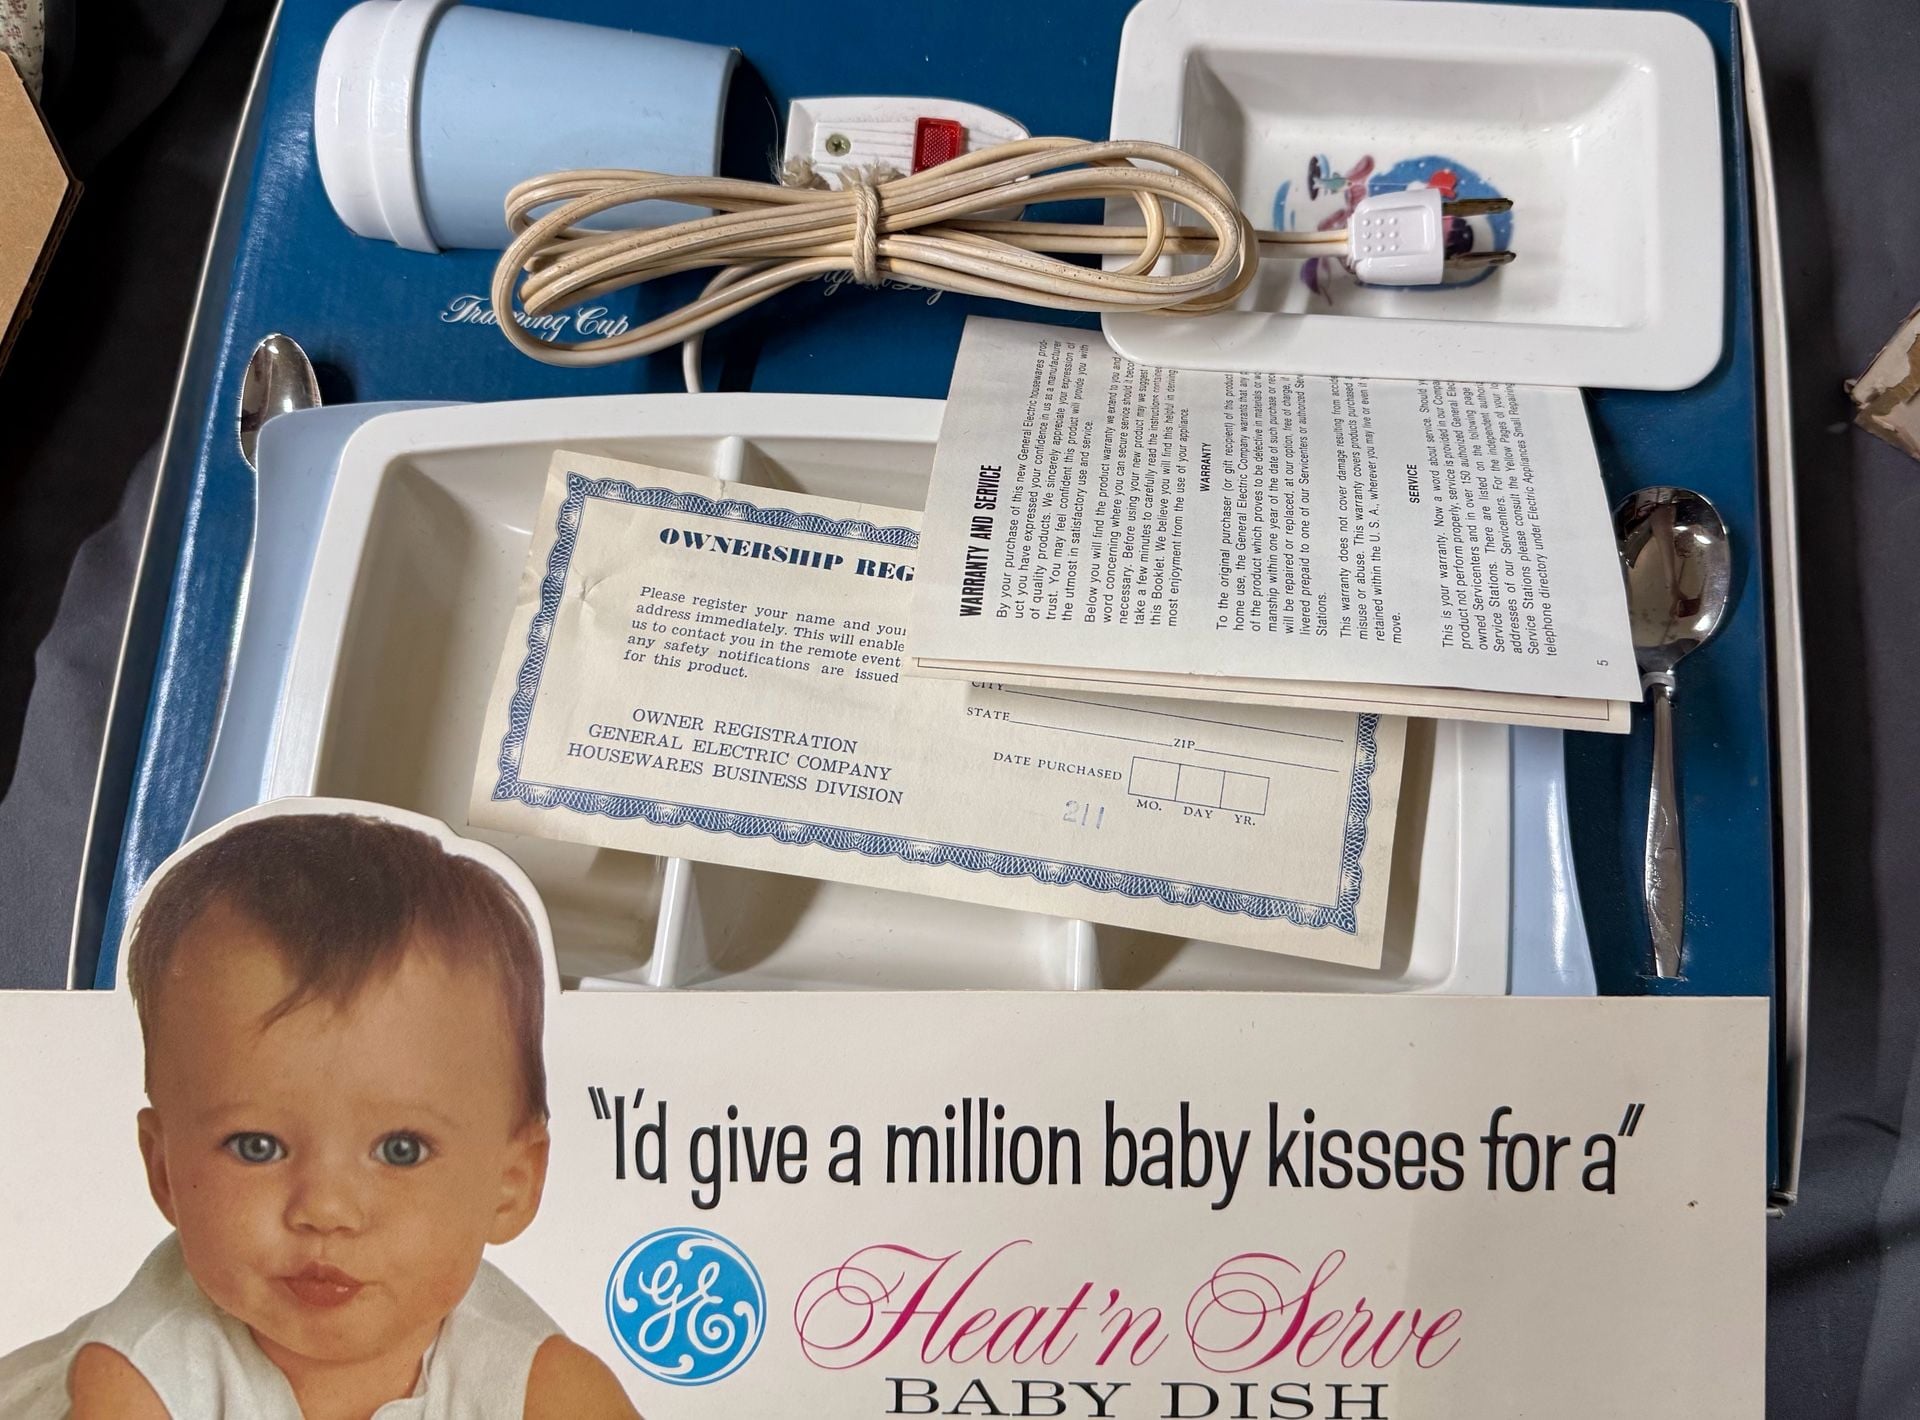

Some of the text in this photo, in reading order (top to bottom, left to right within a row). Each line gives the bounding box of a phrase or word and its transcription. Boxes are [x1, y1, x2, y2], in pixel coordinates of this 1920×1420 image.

[440, 294, 629, 342] Traning Cup
[1046, 340, 1061, 385] manufacturer
[1079, 345, 1088, 359] with
[1061, 353, 1074, 389] expression
[1074, 378, 1085, 399] provide
[1058, 391, 1068, 404] your
[1072, 403, 1081, 414] will
[1417, 388, 1430, 413] Should
[1034, 423, 1048, 464] confidence
[1052, 408, 1065, 445] appreciate
[1067, 417, 1078, 444] product
[1422, 417, 1435, 443] service.
[1045, 449, 1060, 488] sincerely
[1064, 449, 1075, 463] this
[1199, 442, 1212, 492] WARRANTY
[1426, 446, 1439, 466] about
[997, 340, 1048, 618] By your purchase of this new General Electric housewares prod-
[1032, 468, 1041, 488] your
[1058, 467, 1072, 509] confident
[1406, 464, 1420, 504] SERVICE
[1429, 470, 1441, 491] word
[1023, 492, 1038, 541] expressed
[1042, 493, 1053, 508] We
[1167, 408, 1189, 626] most enjoyment from the use of your appliance.
[1344, 383, 1368, 640] misuse or abuse. This warranty covers products purchased
[1433, 507, 1444, 526] Now
[1036, 513, 1051, 560] products.
[1055, 514, 1066, 531] feel
[1062, 420, 1093, 621] the utmost in satisfactory use and service.
[1504, 384, 1557, 656] telephone directory under Electric Appliances Small Repairing
[659, 528, 843, 570] OWNERSHIP
[959, 465, 1001, 617] WARRANTY AND SERVICE
[1018, 545, 1031, 570] have
[1053, 537, 1065, 558] may
[1436, 532, 1448, 579] warranty.
[1017, 576, 1028, 595] you
[1032, 565, 1046, 603] quality
[1049, 563, 1061, 584] You
[639, 586, 686, 603] Please
[692, 593, 748, 614] register
[756, 605, 788, 620] your
[796, 610, 835, 627] name
[843, 616, 870, 632] and
[1014, 601, 1024, 618] uct
[1030, 608, 1040, 619] of
[1046, 591, 1058, 620] trust.
[1316, 592, 1328, 636] Stations.
[1440, 585, 1454, 606] your
[635, 602, 904, 652] address immediately. This will enable
[1391, 612, 1402, 644] move.
[1441, 610, 1452, 619] is
[631, 620, 901, 667] us to contact you in the remote event
[1441, 624, 1454, 647] This
[623, 650, 748, 679] for this product.
[627, 634, 899, 683] any safety notifications are issued
[633, 708, 857, 754] OWNER REGISTRATION
[967, 706, 1195, 751] STATE ZIP
[588, 723, 892, 781] GENERAL ELECTRIC COMPANY
[994, 751, 1122, 781] DATE PURCHASED
[568, 742, 903, 805] HOUSEWARES BUSINESS DIVISION
[1136, 799, 1256, 827] MO. DAY YR.
[690, 1105, 808, 1212] give
[828, 1125, 860, 1186] a
[884, 1100, 1082, 1186] million
[1105, 1102, 1251, 1212] baby
[1269, 1102, 1464, 1192] kisses
[1479, 1105, 1569, 1192] for
[1185, 1249, 1462, 1373] Serve
[884, 1377, 1390, 1420] BABY DISH
